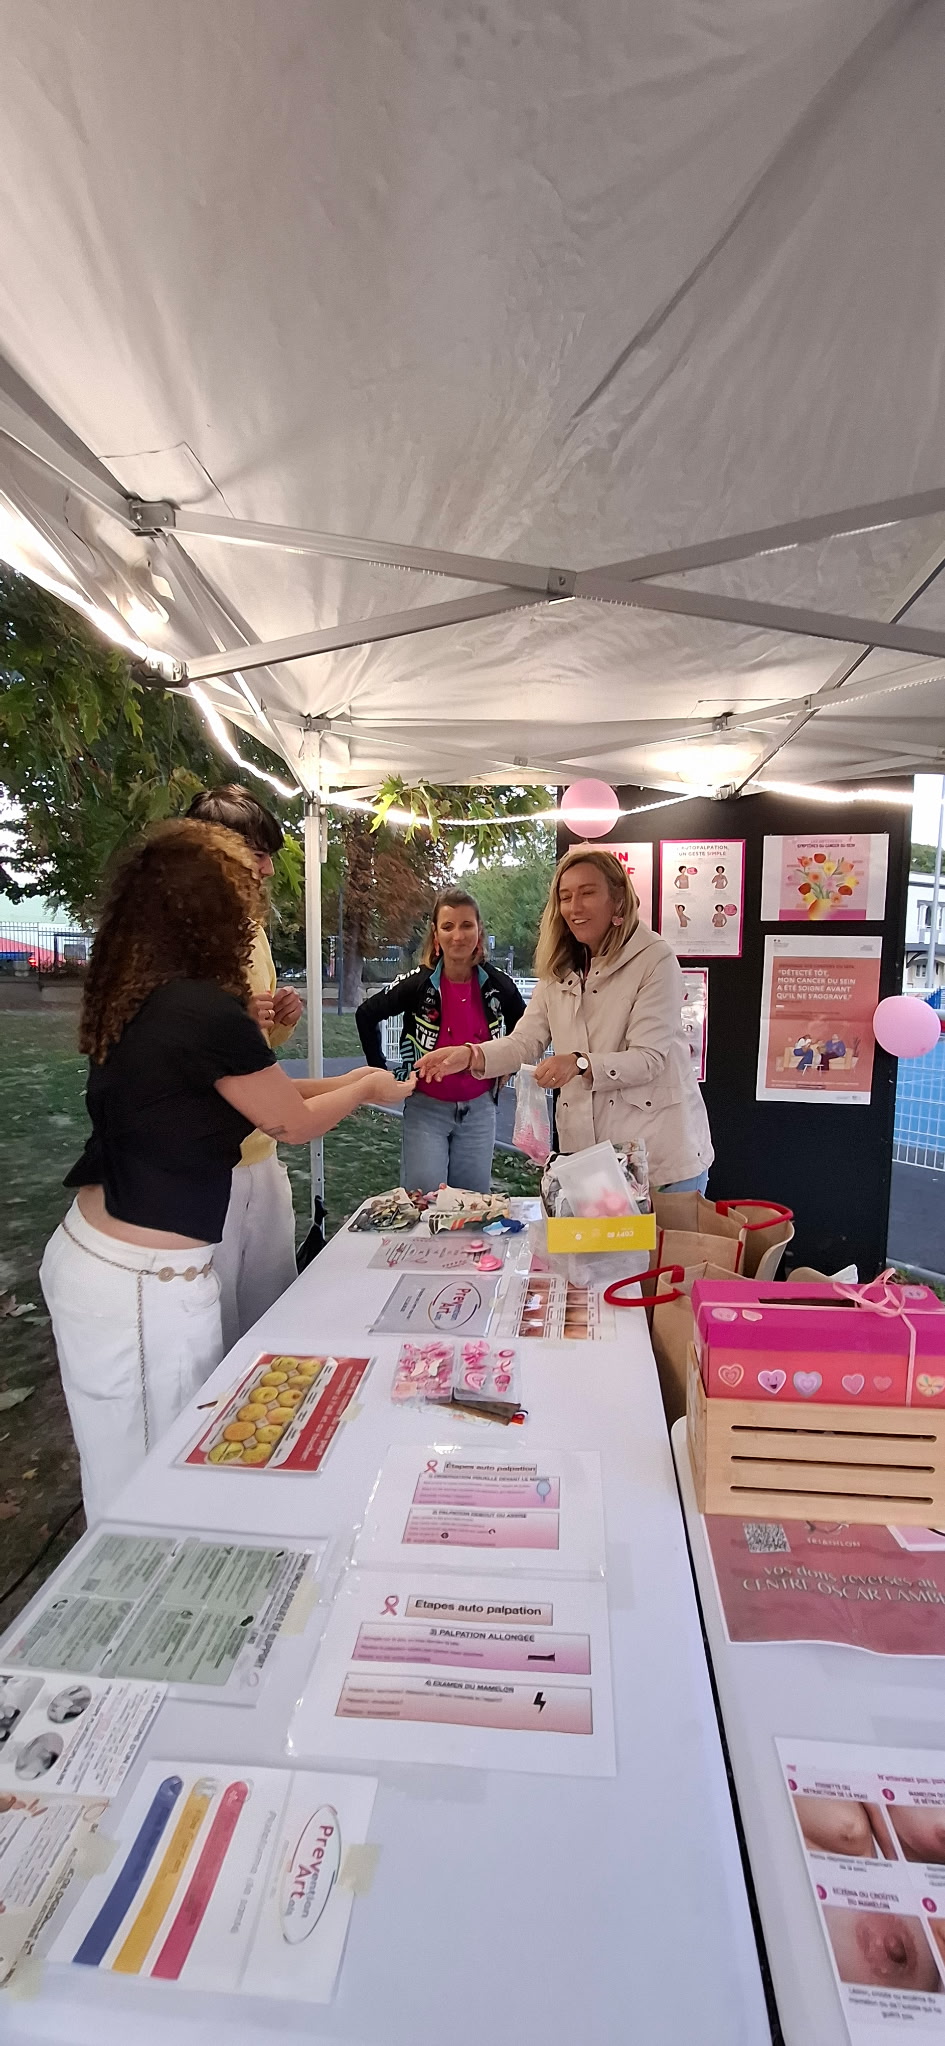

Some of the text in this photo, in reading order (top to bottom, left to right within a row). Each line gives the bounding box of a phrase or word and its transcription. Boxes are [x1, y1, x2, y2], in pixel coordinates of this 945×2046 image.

[496, 1465, 537, 1473] palpation
[807, 1537, 860, 1548] TRIATHLON
[763, 1566, 792, 1576] vos
[797, 1565, 837, 1582] dons
[918, 1579, 938, 1590] au
[742, 1578, 808, 1592] CENTRE
[817, 1582, 881, 1601] OSCAR
[415, 1599, 542, 1616] Etapes auto palpation
[439, 1628, 486, 1640] PALPATION
[432, 1680, 464, 1688] EXAMEN
[464, 1682, 476, 1690] DU
[301, 1825, 335, 1919] Prevention
[847, 1898, 890, 1910] DU MAMELON
